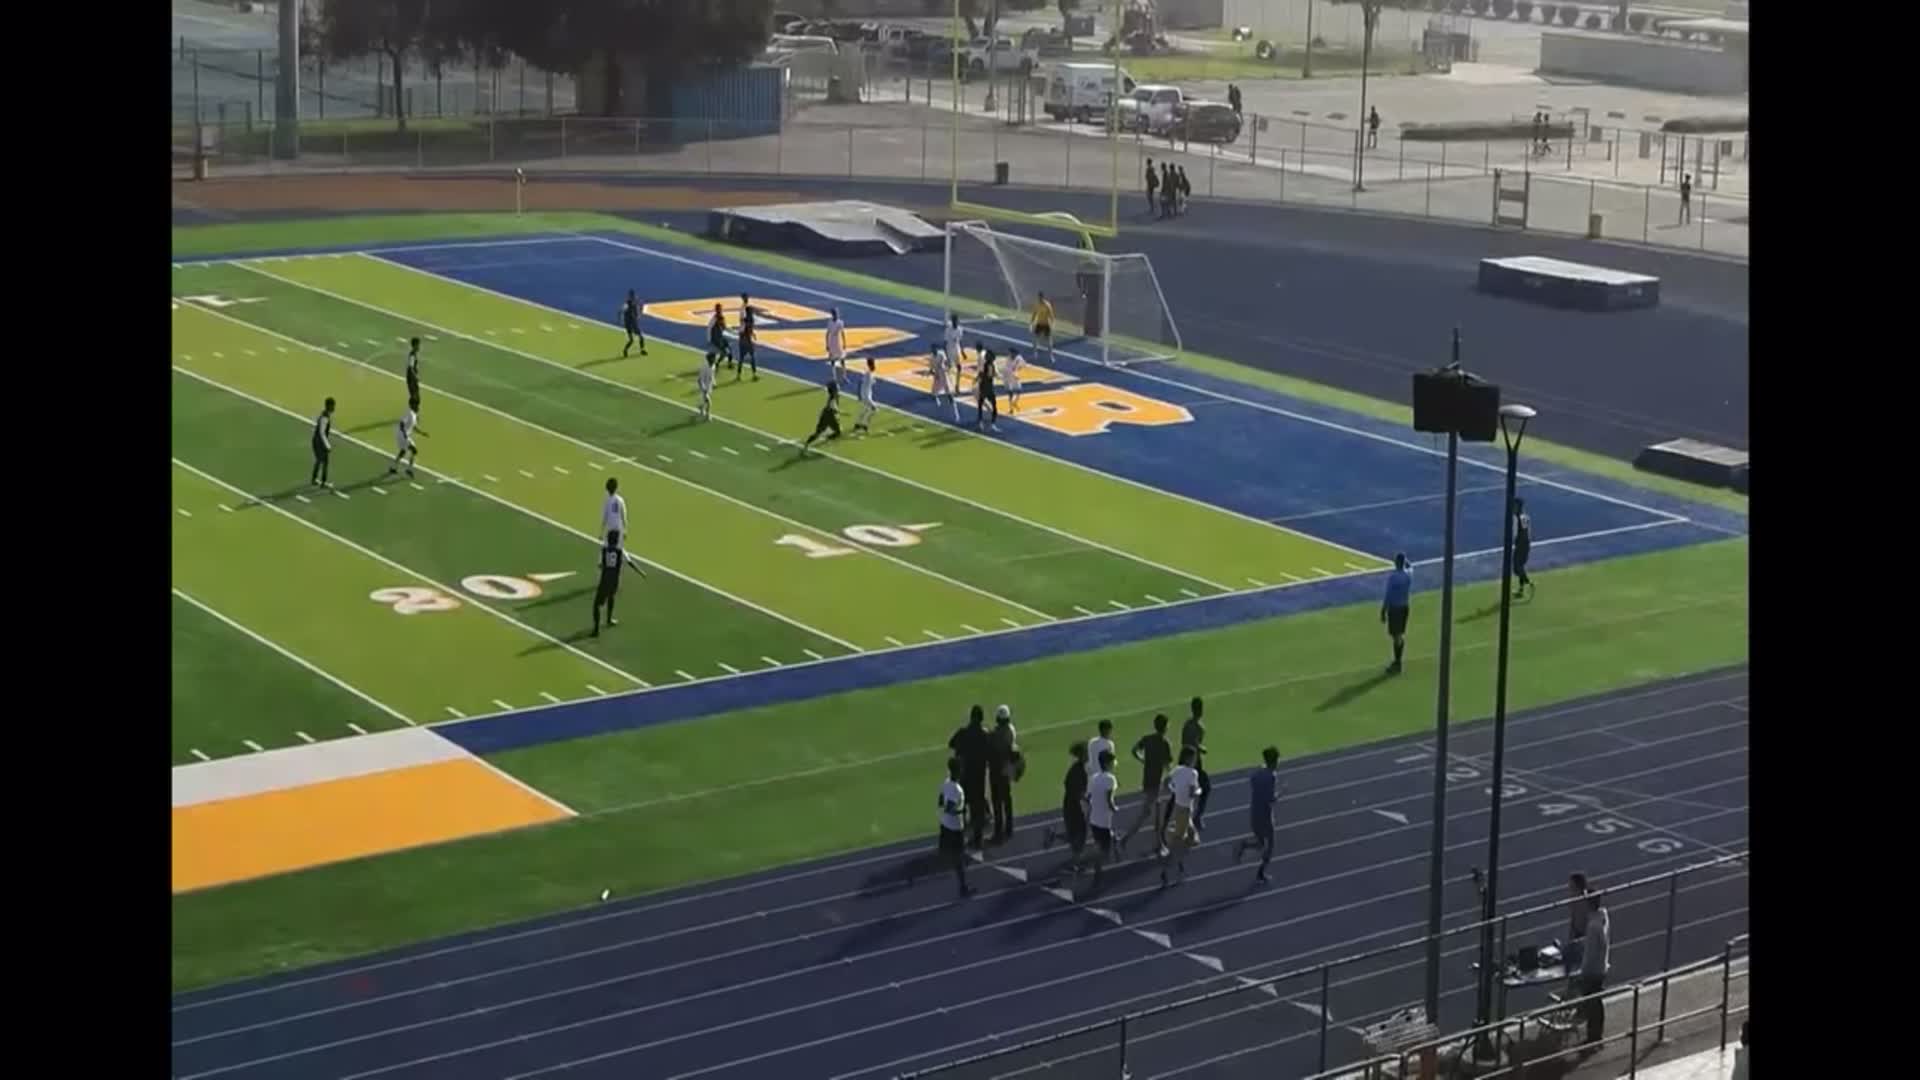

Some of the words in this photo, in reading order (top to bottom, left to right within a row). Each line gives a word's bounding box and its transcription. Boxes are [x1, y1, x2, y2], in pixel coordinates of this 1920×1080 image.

[773, 522, 922, 559] 10
[368, 572, 544, 616] 20
[1537, 803, 1579, 815] 4
[1584, 818, 1634, 834] 5
[1637, 837, 1684, 854] 6
